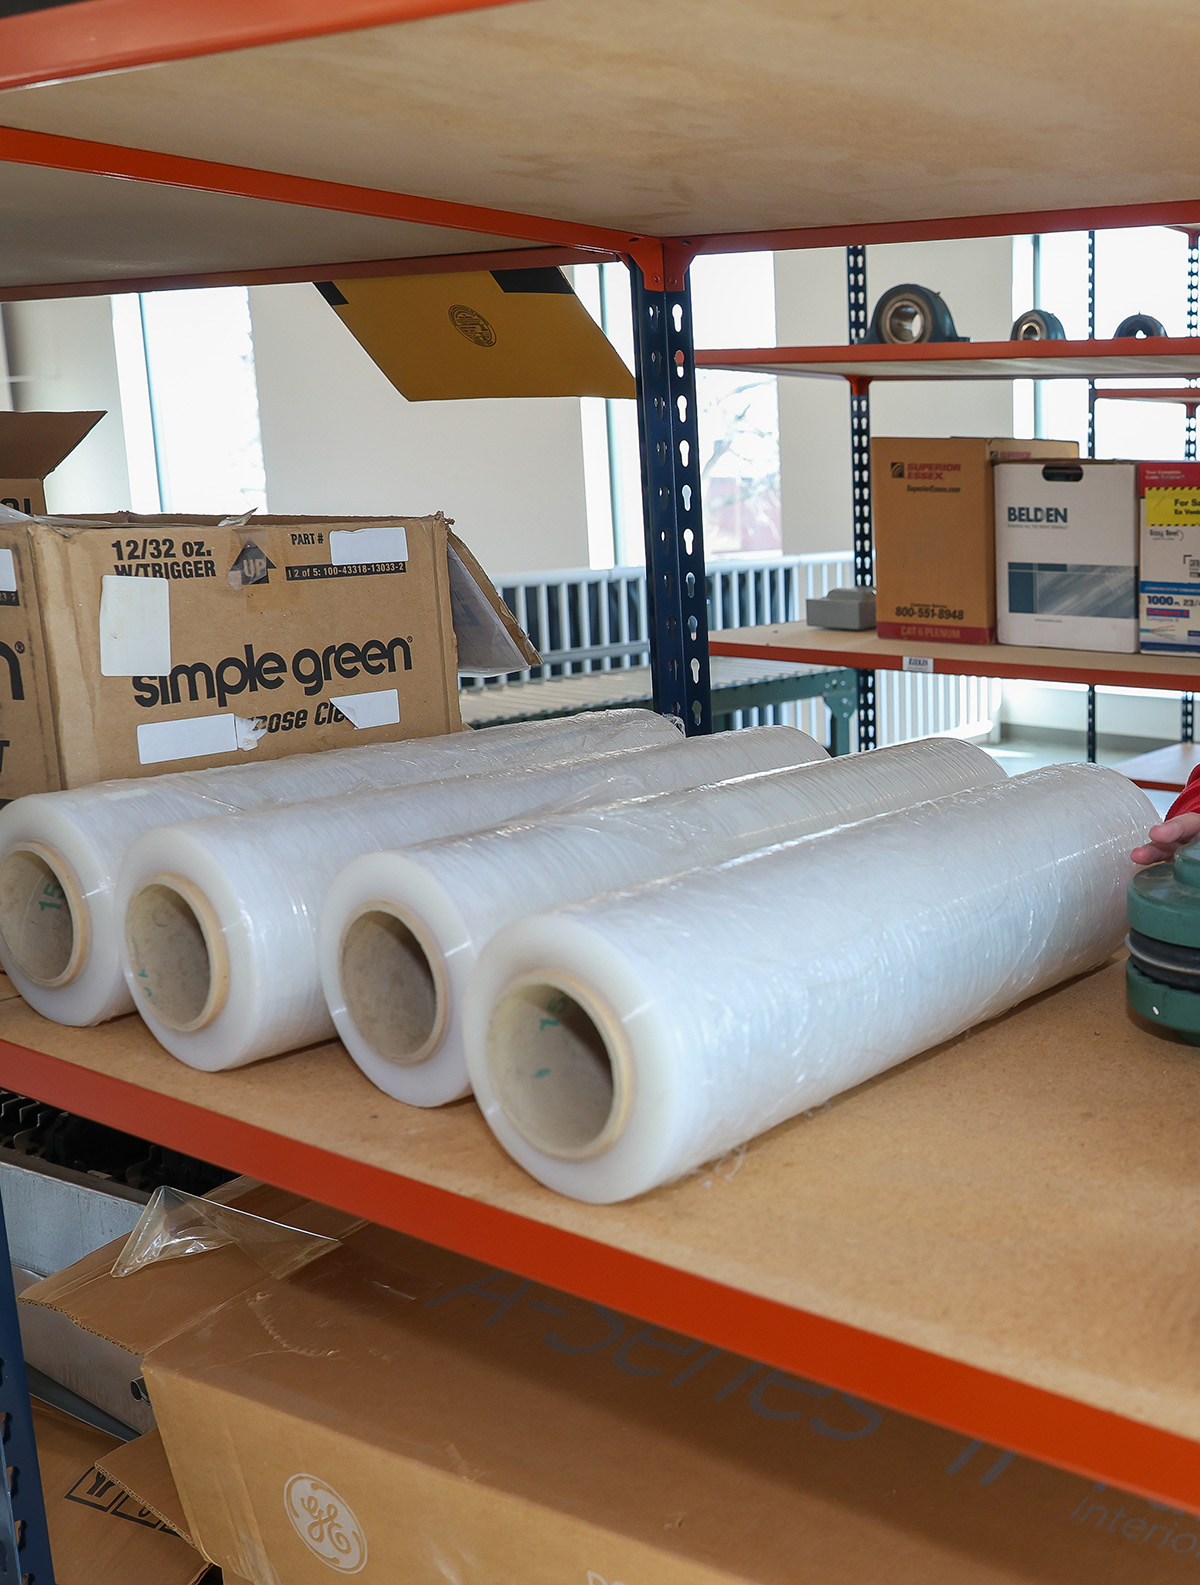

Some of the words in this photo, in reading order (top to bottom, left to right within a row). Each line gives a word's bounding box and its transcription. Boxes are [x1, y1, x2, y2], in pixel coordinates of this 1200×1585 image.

[907, 462, 961, 472] SUPERIOR
[907, 472, 943, 480] ESSEX
[1174, 499, 1189, 507] For
[1007, 506, 1068, 523] BELDEN
[290, 533, 316, 545] PART
[317, 532, 325, 545] #
[111, 538, 176, 561] 12/32
[181, 540, 212, 559] oz.
[113, 559, 217, 580] W/TRIGGER
[242, 558, 267, 578] UP
[1147, 595, 1174, 606] 1000
[894, 606, 965, 621] 800-551-8948
[132, 643, 287, 708] simple
